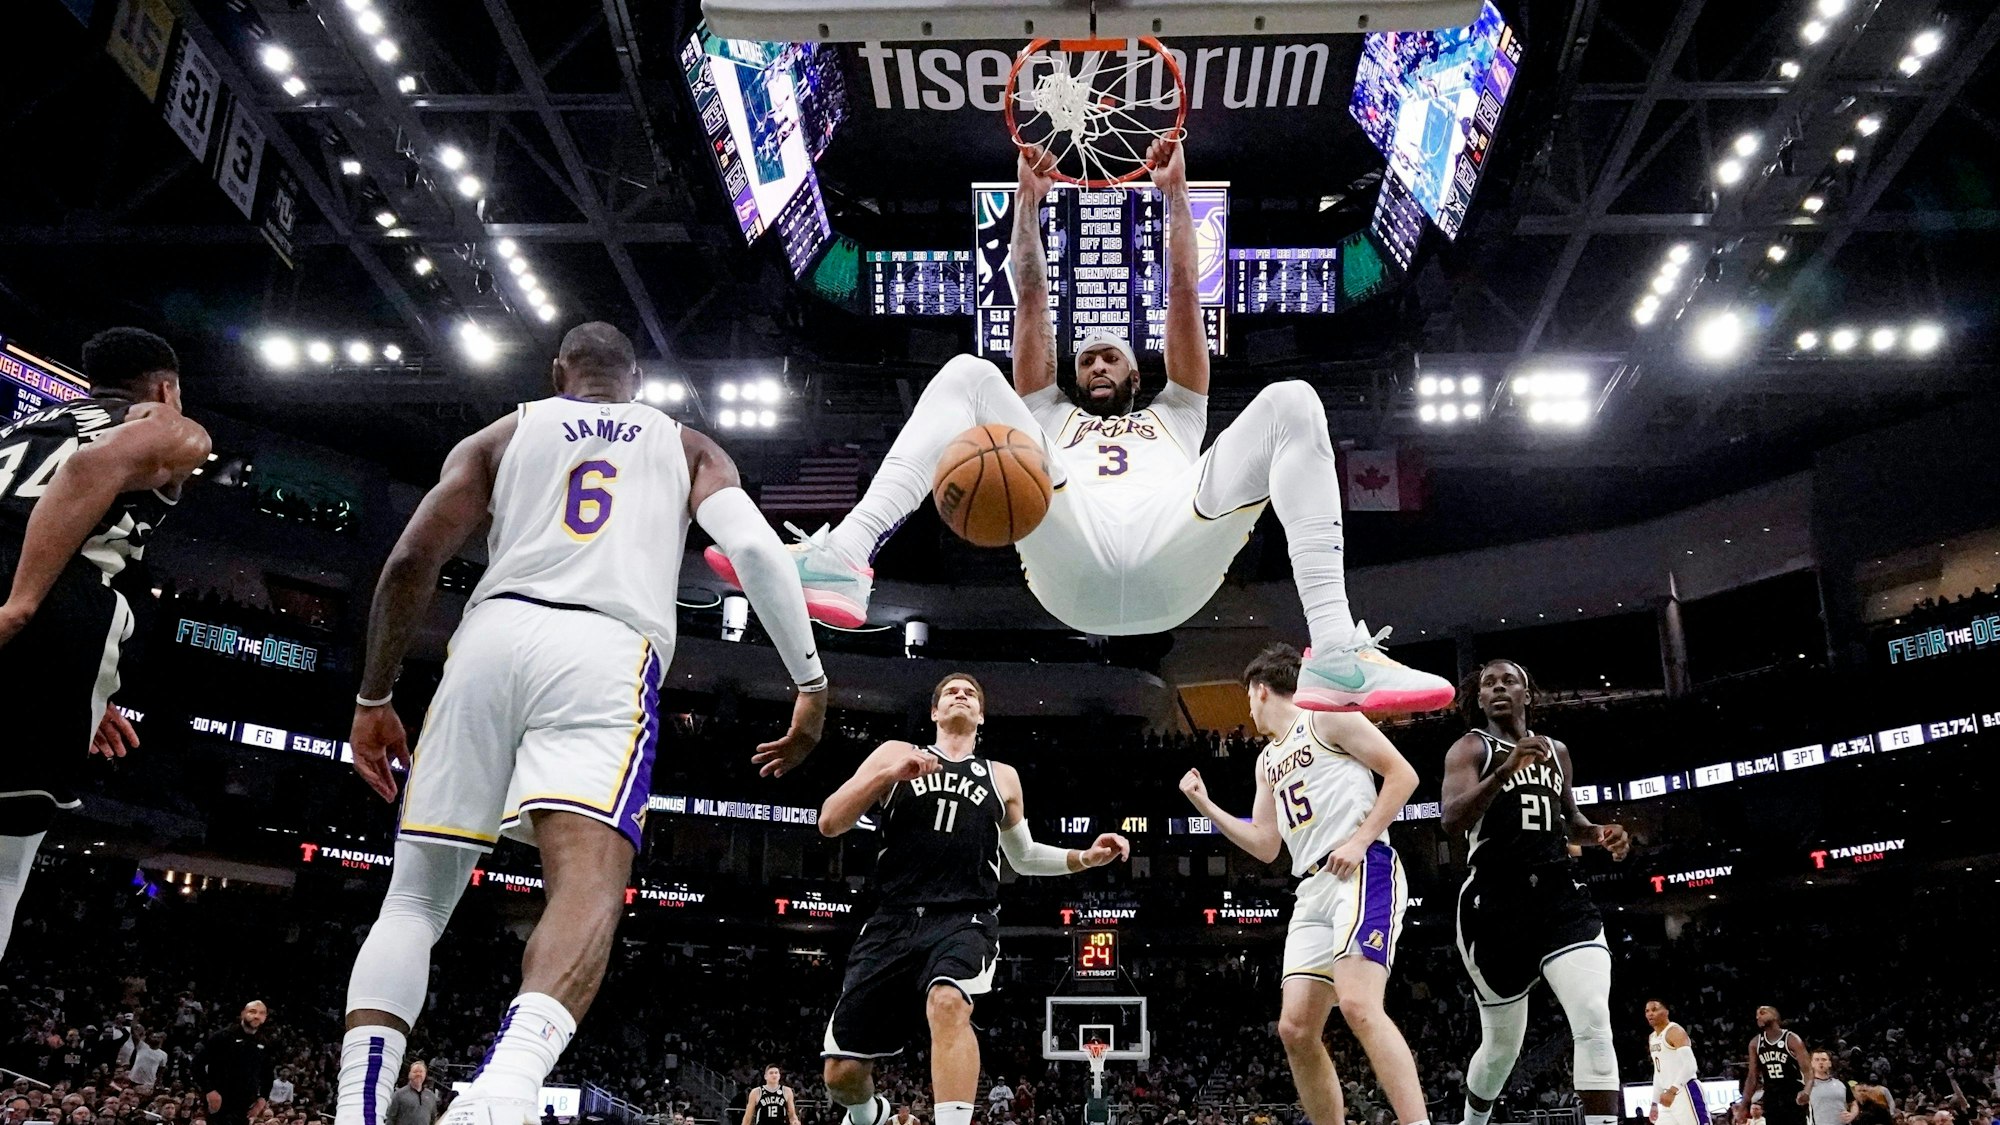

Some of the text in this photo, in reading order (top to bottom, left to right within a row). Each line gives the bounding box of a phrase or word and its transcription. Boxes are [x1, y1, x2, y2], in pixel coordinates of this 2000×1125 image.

[1116, 36, 1329, 111] forum
[180, 69, 211, 135] 31
[233, 136, 253, 184] 3
[1078, 192, 1123, 205] ASSISTS
[1080, 207, 1122, 220] BLOCKS
[1145, 206, 1152, 217] 4
[1049, 221, 1152, 235] 2 STEALS 5
[1048, 235, 1152, 250] 10 OFF REB 11
[1047, 249, 1154, 265] 30 DEF REB 30
[1048, 265, 1152, 280] 10 TURNOVERS 4
[1322, 261, 1328, 270] 4
[1239, 271, 1245, 281] 3
[1322, 271, 1328, 281] 2
[1048, 280, 1059, 292] 14
[1076, 281, 1106, 294] TOTAL
[1143, 280, 1155, 292] 16
[1238, 282, 1245, 292] 4
[875, 305, 885, 315] 34
[1076, 296, 1106, 309] BENCH
[1108, 296, 1127, 309] PTS
[989, 310, 1010, 322] 53.8
[1072, 311, 1098, 323] FIELD
[1100, 311, 1130, 323] GOALS
[991, 325, 1009, 337] 41.5
[1149, 324, 1165, 336] 11/2
[989, 338, 1166, 351] 80.0 17/2
[18, 388, 42, 407] 51/95
[562, 418, 642, 443] JAMES
[1063, 417, 1158, 449] LAKERS
[1097, 444, 1129, 477] 3
[561, 459, 619, 542] 6
[176, 618, 317, 672] FEAR THE DEER
[1888, 628, 1947, 665] FEAR
[1945, 627, 1973, 646] THE
[210, 720, 227, 735] PM
[255, 729, 273, 744] FG
[292, 735, 331, 756] 53.8%
[1603, 787, 1613, 800] 5
[1637, 780, 1660, 795] TOL
[1672, 776, 1681, 790] 2
[1706, 767, 1721, 781] FT
[1736, 756, 1775, 777] 85.0%
[1793, 750, 1815, 766] 3PT
[1829, 737, 1871, 758] 42.3%
[1893, 731, 1910, 746] FG
[1929, 716, 1974, 739] 53.7%
[1266, 744, 1314, 792] LAKERS
[910, 772, 988, 806] BUCKS
[649, 795, 817, 825] BONUS MILWAUKEE BUCKS
[1279, 780, 1314, 831] 15
[1520, 793, 1552, 832] 21
[934, 798, 958, 833] 11
[1061, 817, 1147, 833] 1:07 4TH
[1188, 817, 1212, 834] 130
[321, 846, 393, 867] TANDUAY
[1829, 839, 1905, 860] TANDUAY
[341, 860, 371, 871] RUM
[1853, 852, 1884, 864] RUM
[487, 872, 546, 889] TANDUA
[1667, 865, 1733, 884] TANDUAY
[505, 883, 532, 894] RUM
[1688, 877, 1714, 889] RUM
[640, 889, 705, 903] TANDUAY
[659, 899, 685, 908] RUM
[792, 900, 853, 913] TANDUAY
[809, 910, 834, 918] RUM
[1220, 908, 1279, 918] TANDUAY
[1090, 932, 1113, 947] 1:07
[1083, 945, 1110, 967] 24
[1088, 969, 1116, 977] TISSOT
[1758, 1050, 1788, 1065] BUCKS
[1766, 1063, 1784, 1079] 22
[760, 1096, 785, 1108] BUCKS
[767, 1105, 778, 1117] 12
